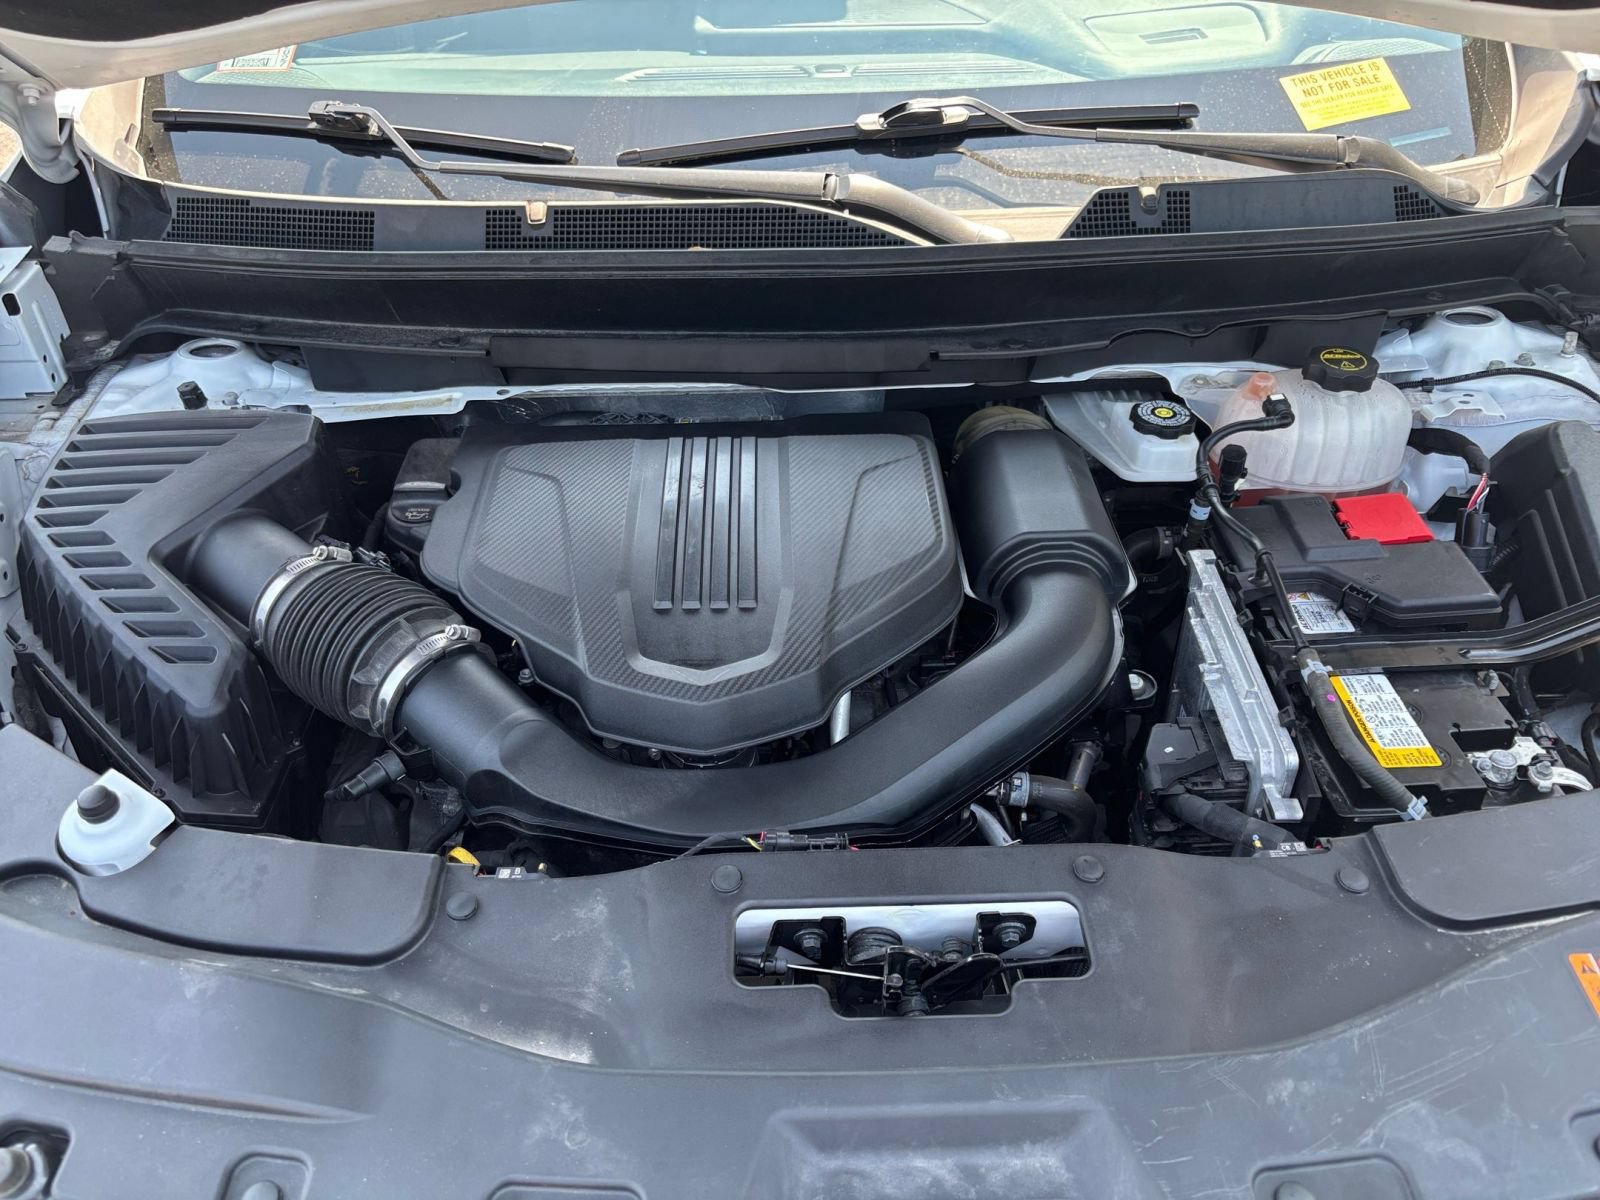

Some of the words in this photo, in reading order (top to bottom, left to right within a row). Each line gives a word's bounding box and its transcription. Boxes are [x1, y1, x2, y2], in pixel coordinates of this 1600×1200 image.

[1291, 75, 1318, 87] THIS
[1319, 65, 1366, 80] VEHICLE
[1368, 61, 1380, 71] IS
[1302, 85, 1325, 97] NOT
[1327, 80, 1351, 92] FOR
[1353, 74, 1381, 87] SALE
